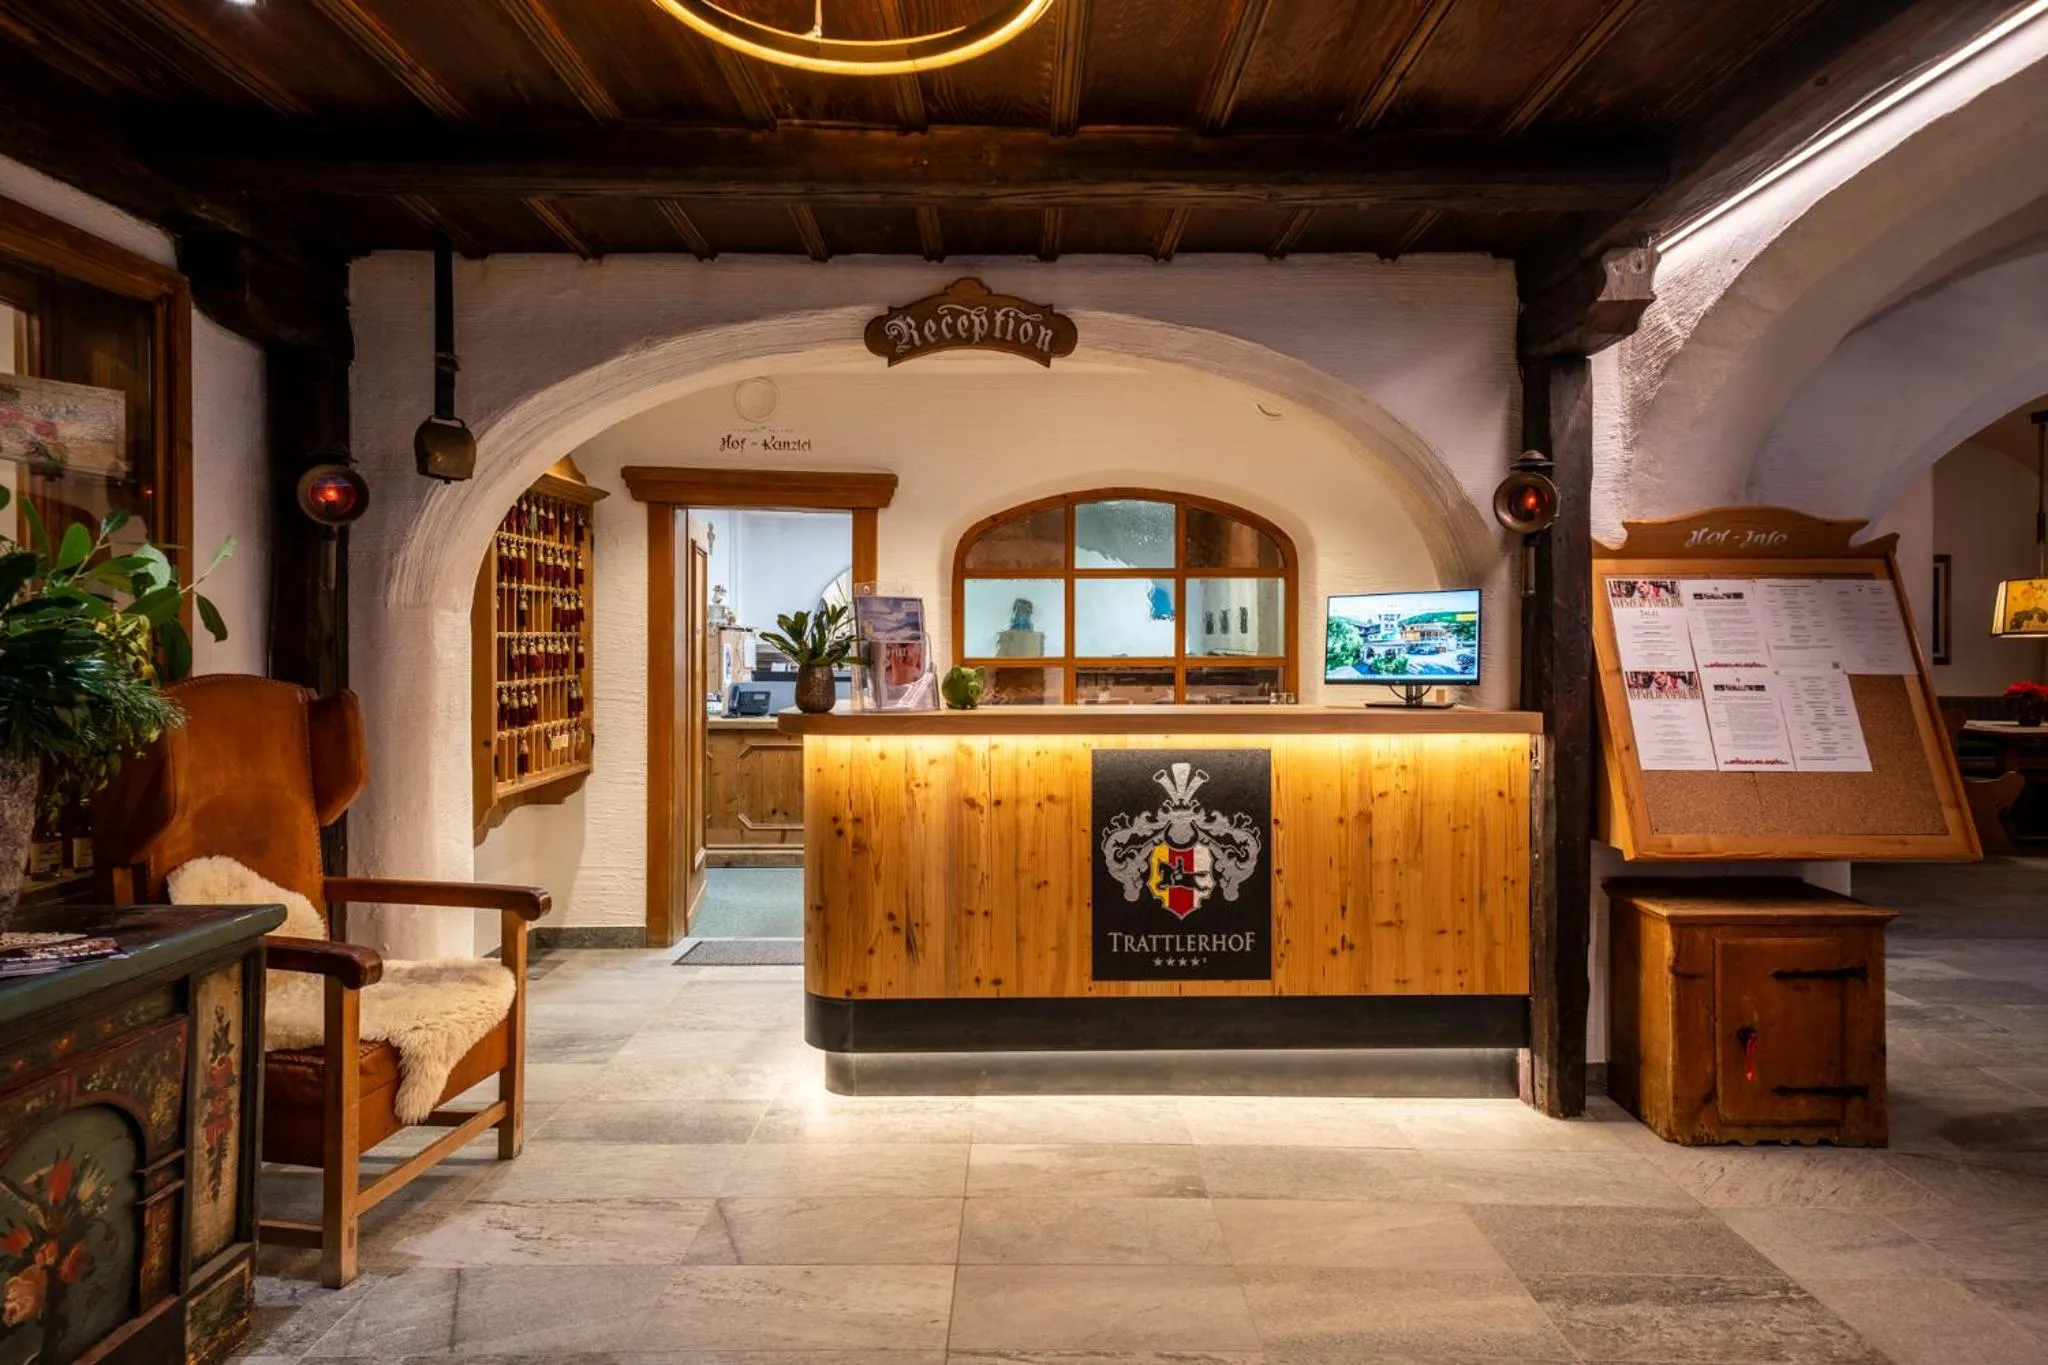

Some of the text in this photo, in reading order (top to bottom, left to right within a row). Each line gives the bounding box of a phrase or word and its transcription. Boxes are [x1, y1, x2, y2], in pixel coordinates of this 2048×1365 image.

[885, 304, 1054, 353] Reception
[719, 434, 746, 452] Hof
[1685, 527, 1731, 548] Hof
[1740, 530, 1788, 548] Info
[1107, 932, 1256, 952] TRATTLERHOF
